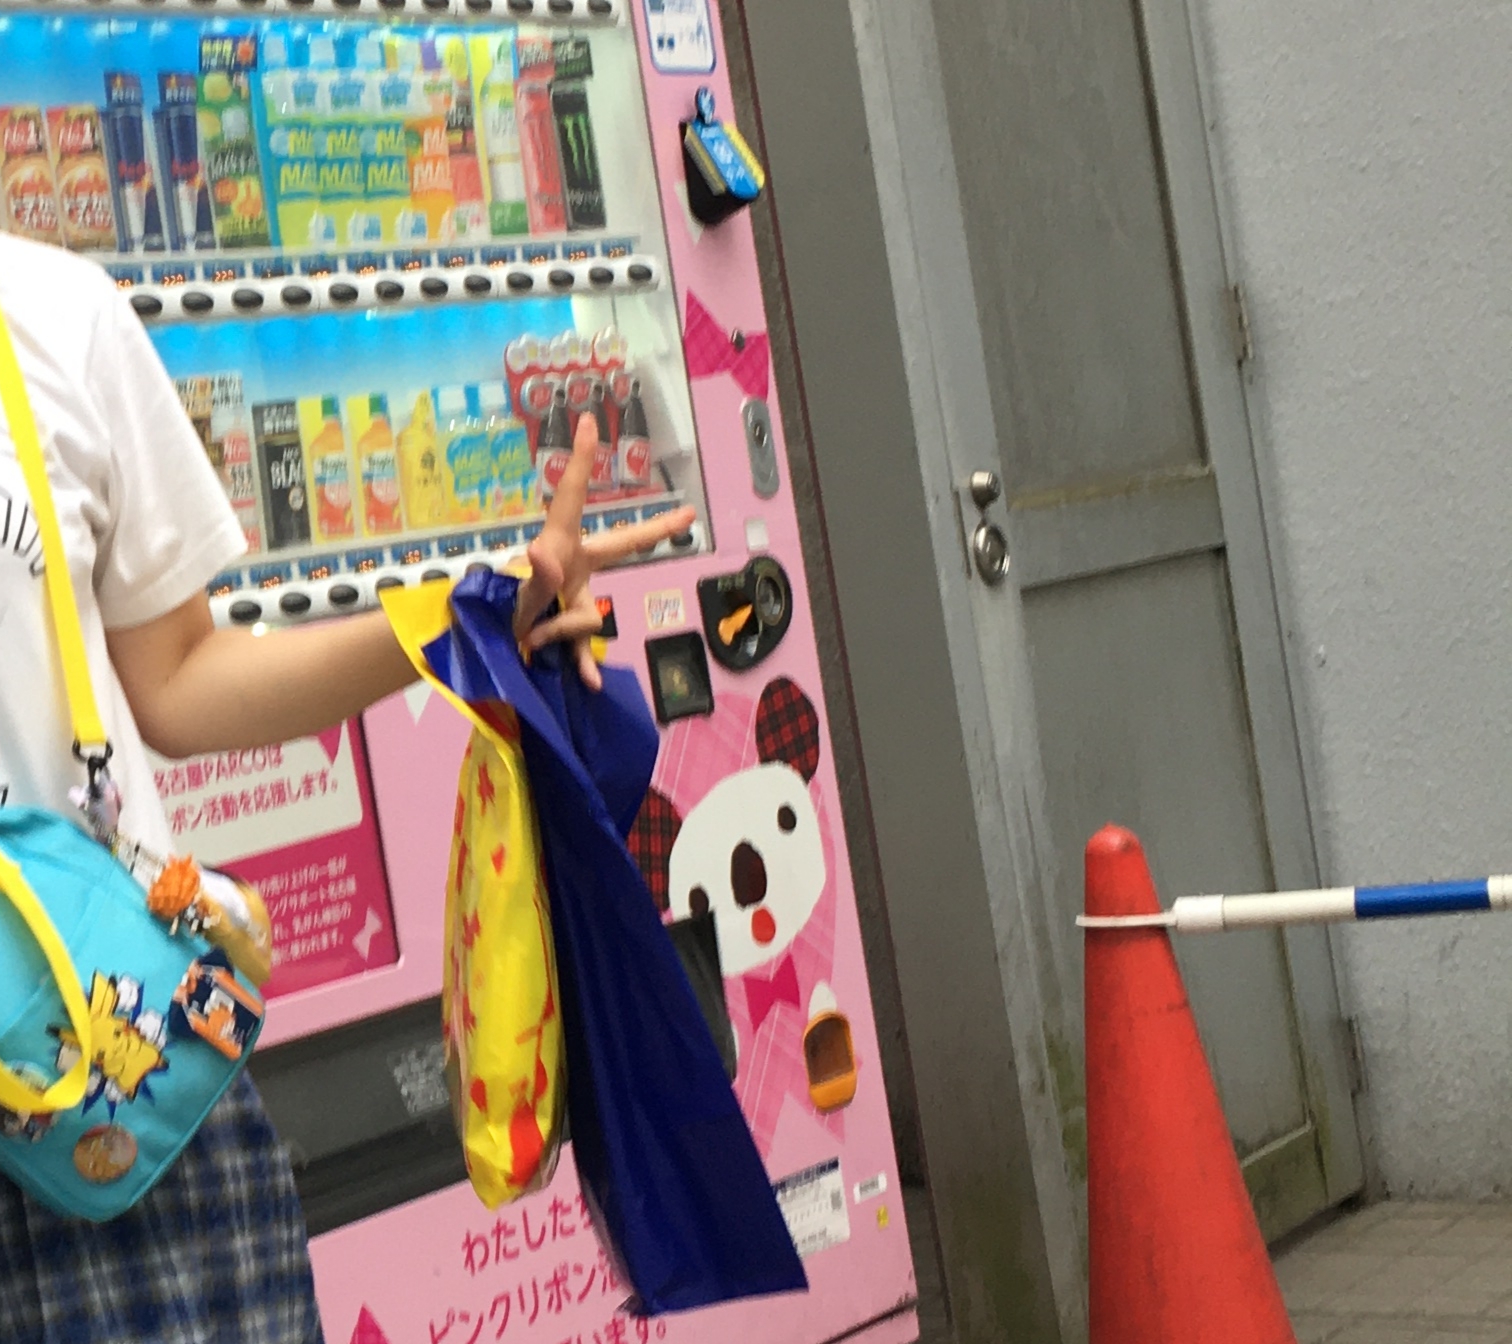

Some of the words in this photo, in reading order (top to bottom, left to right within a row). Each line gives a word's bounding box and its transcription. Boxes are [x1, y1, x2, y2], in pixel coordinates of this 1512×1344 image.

[168, 770, 340, 838] ボン活動を応援します。
